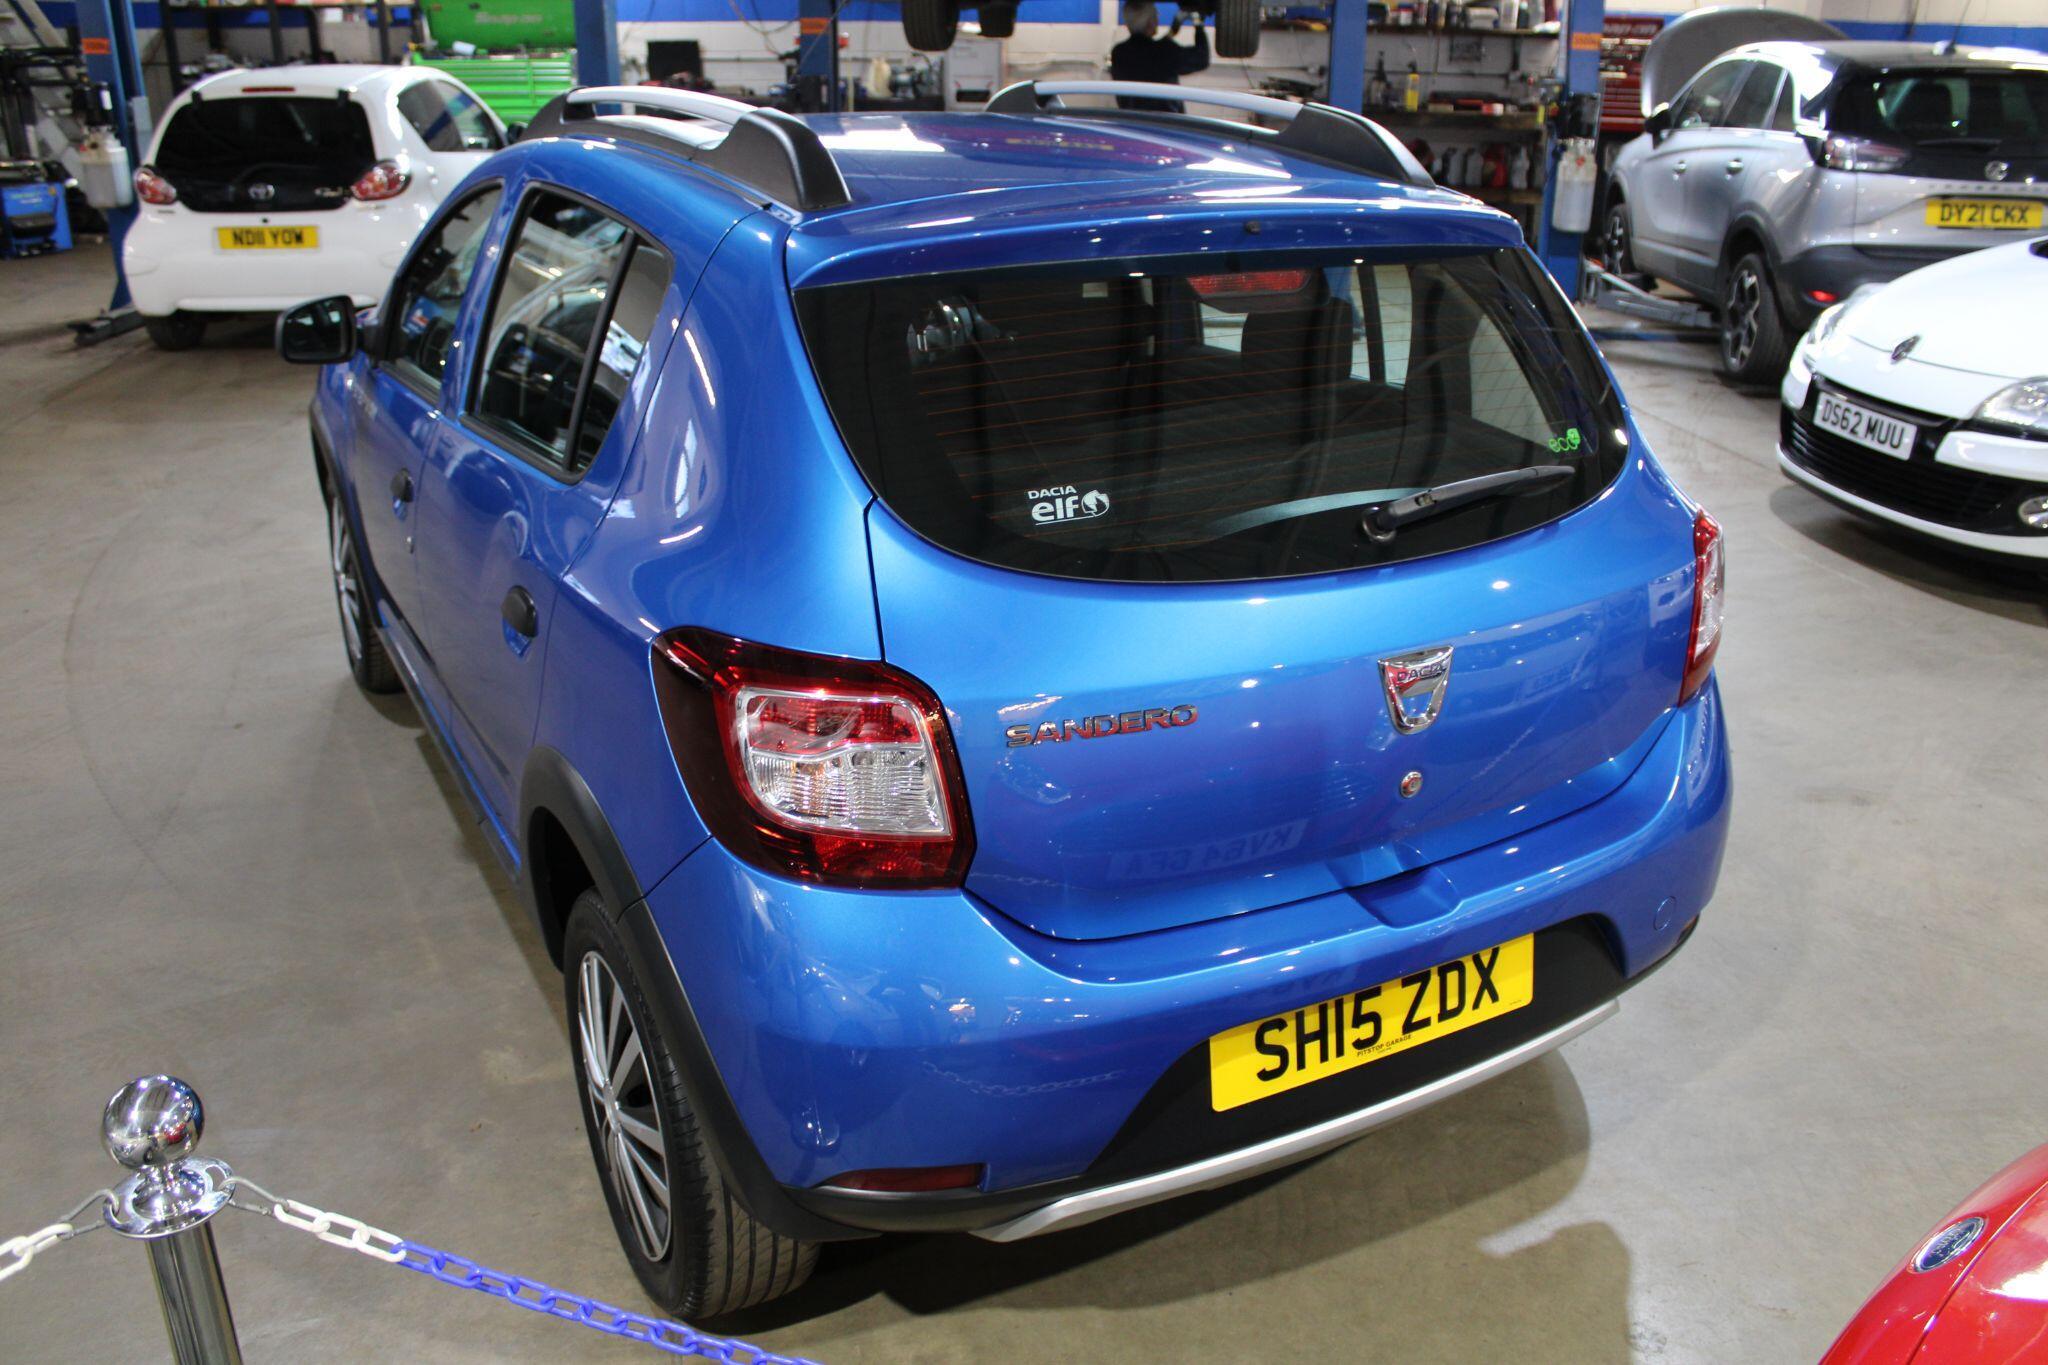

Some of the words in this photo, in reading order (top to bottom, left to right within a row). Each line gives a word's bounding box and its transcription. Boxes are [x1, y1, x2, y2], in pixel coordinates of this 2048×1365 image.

[1940, 203, 1985, 222] DY21
[1990, 204, 2029, 223] CKX
[1822, 400, 1863, 436] DS62
[1864, 415, 1905, 449] MUU
[1027, 485, 1077, 500] DACIA
[1031, 495, 1079, 522] elf
[1006, 704, 1198, 747] SANDERO
[1254, 985, 1383, 1082] SH15
[1401, 946, 1500, 1034] ZDX
[1357, 1043, 1385, 1057] PITSTOP
[1385, 1034, 1412, 1048] GARAGE
